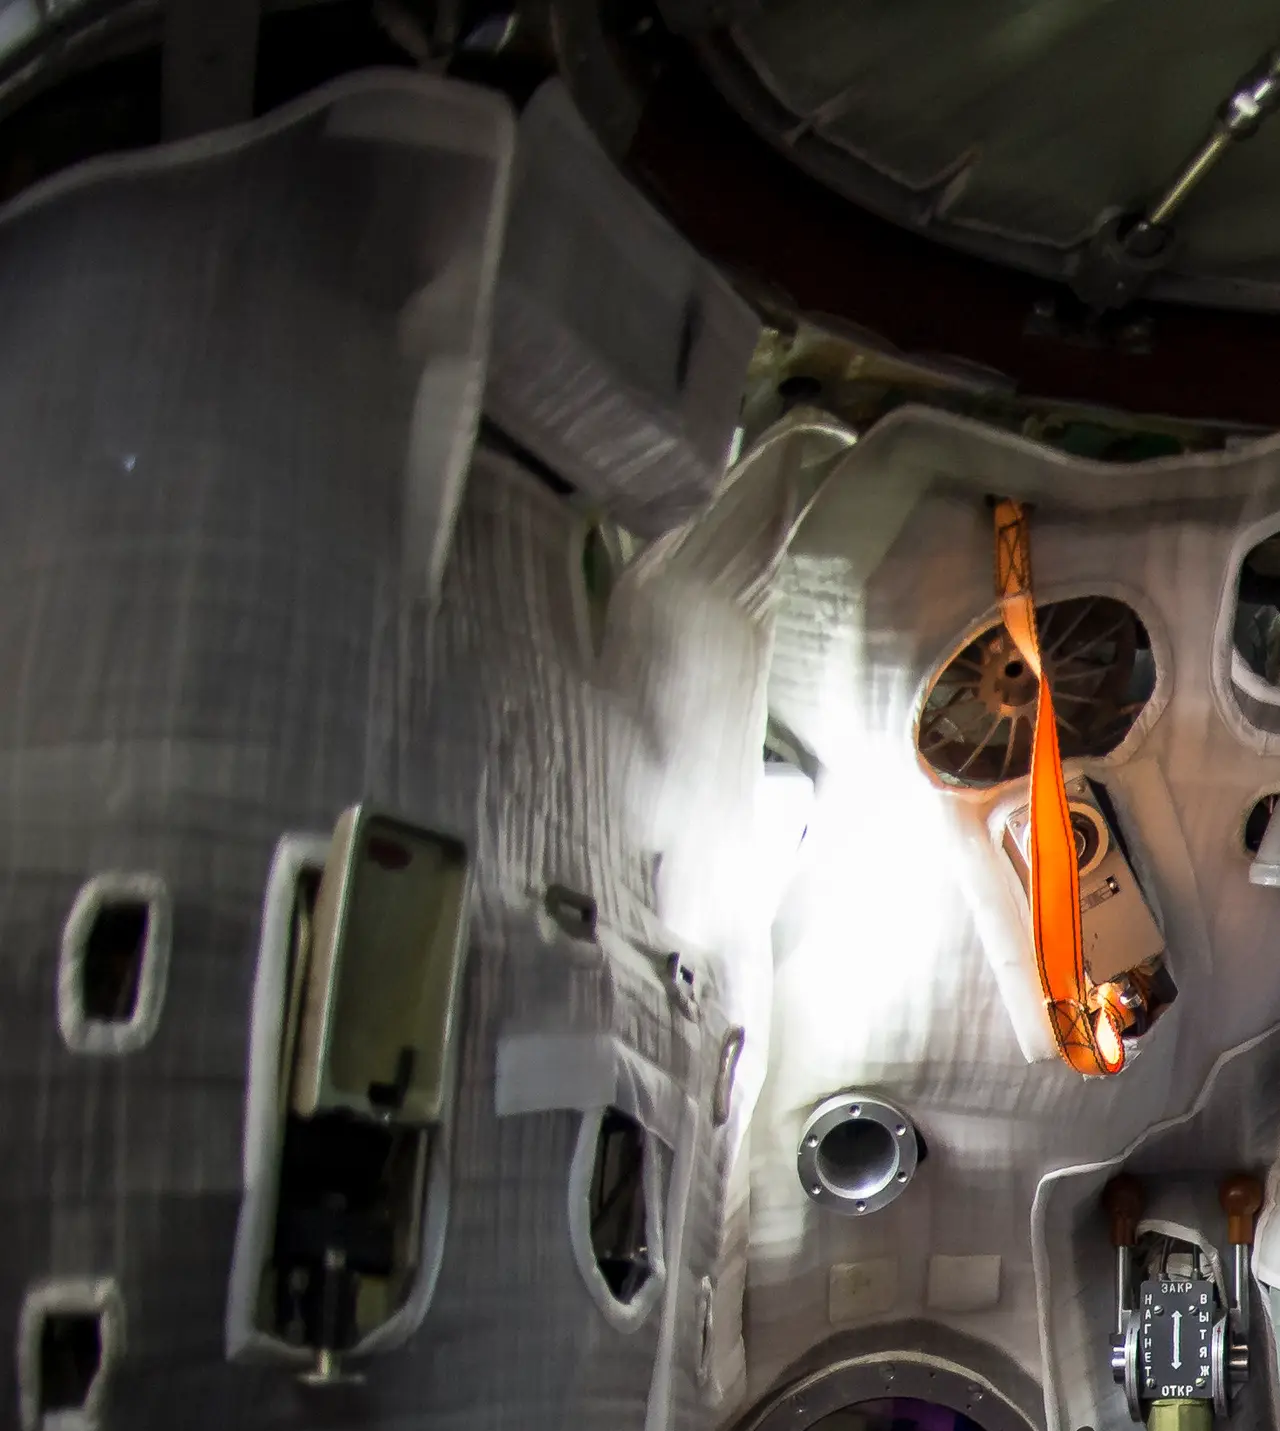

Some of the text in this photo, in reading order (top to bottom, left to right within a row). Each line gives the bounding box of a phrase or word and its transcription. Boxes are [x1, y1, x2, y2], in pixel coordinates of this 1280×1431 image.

[1161, 1282, 1193, 1294] ЗАКР
[1144, 1294, 1152, 1378] НАГНЕТ
[1199, 1293, 1210, 1377] ВЫТЯЖ
[1161, 1385, 1194, 1397] ОТКР
